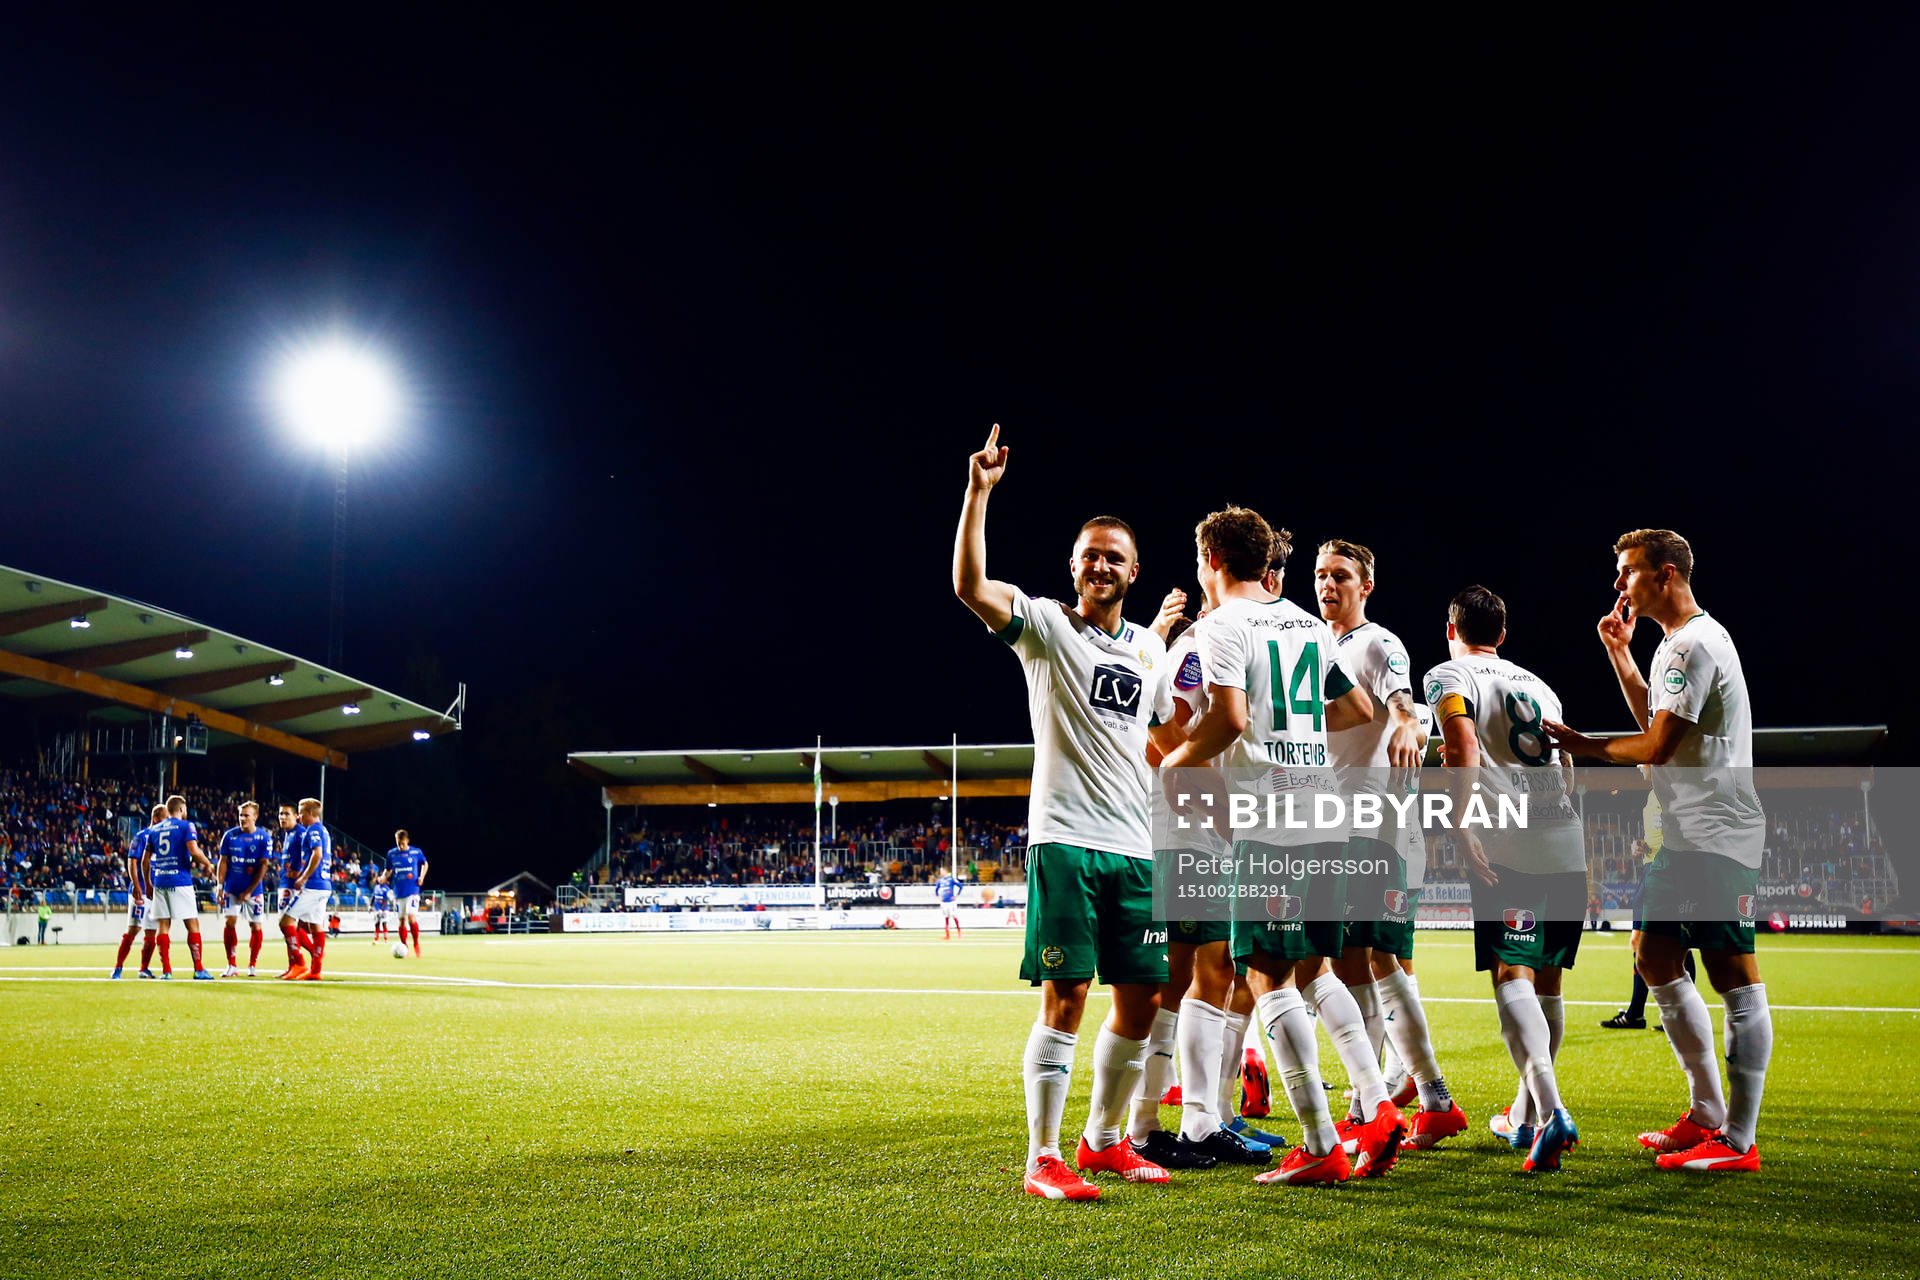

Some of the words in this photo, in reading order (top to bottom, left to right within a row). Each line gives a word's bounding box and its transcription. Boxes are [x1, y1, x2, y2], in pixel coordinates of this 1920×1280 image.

[1266, 639, 1324, 732] 14
[1505, 690, 1552, 767] 8
[159, 831, 171, 855] 5
[634, 895, 660, 904] NCC
[684, 895, 711, 904] NCC
[827, 886, 879, 900] uhlsport
[1789, 914, 1847, 928] ASSALUB
